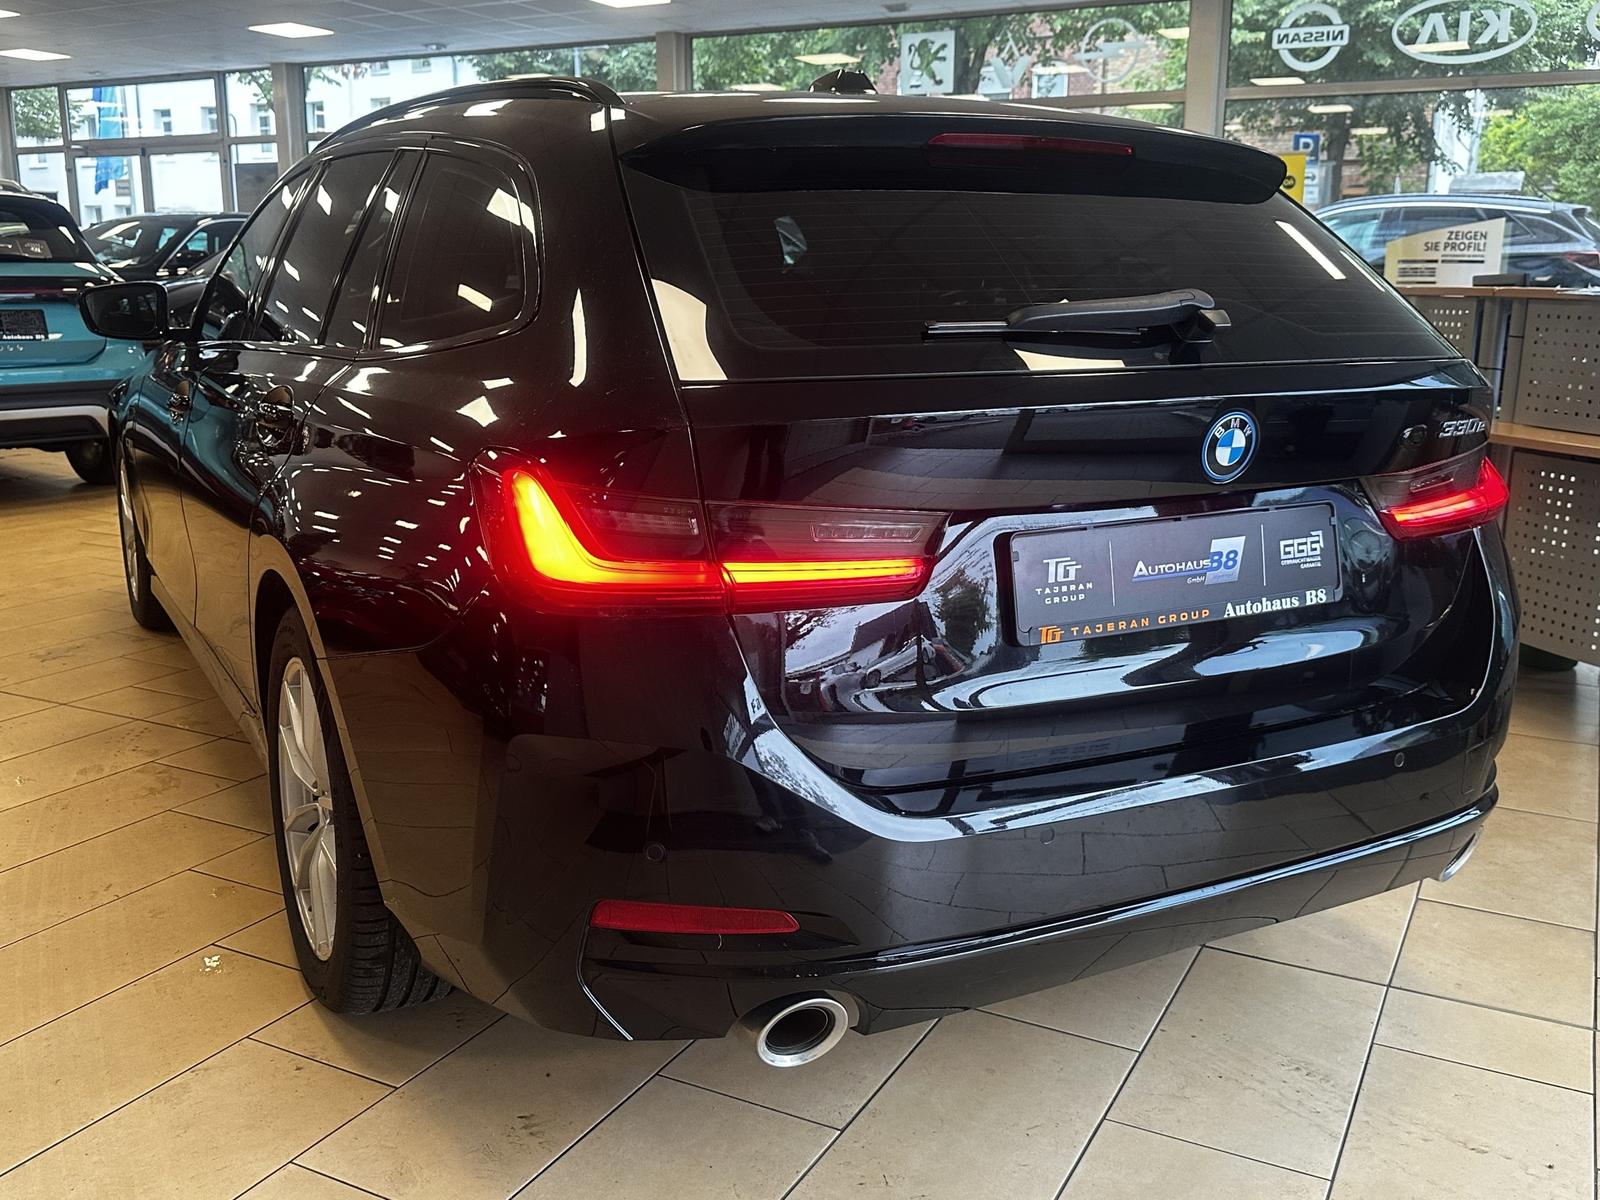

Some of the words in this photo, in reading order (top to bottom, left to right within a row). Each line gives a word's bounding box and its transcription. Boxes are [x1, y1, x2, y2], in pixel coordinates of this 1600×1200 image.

[1447, 230, 1488, 241] ZEIGEN
[1423, 241, 1440, 252] SIE
[1443, 241, 1487, 252] PROFIL!
[1214, 418, 1252, 438] BMW
[1438, 418, 1485, 438] 330e
[1207, 550, 1239, 573] B8
[1187, 575, 1206, 584] GmbH
[1035, 582, 1093, 595] TAJERAN
[1045, 593, 1085, 605] GROUP
[1223, 596, 1300, 618] Autohaus
[1305, 588, 1327, 606] B8
[1071, 618, 1149, 636] TAJERAN
[1158, 609, 1210, 624] GROUP
